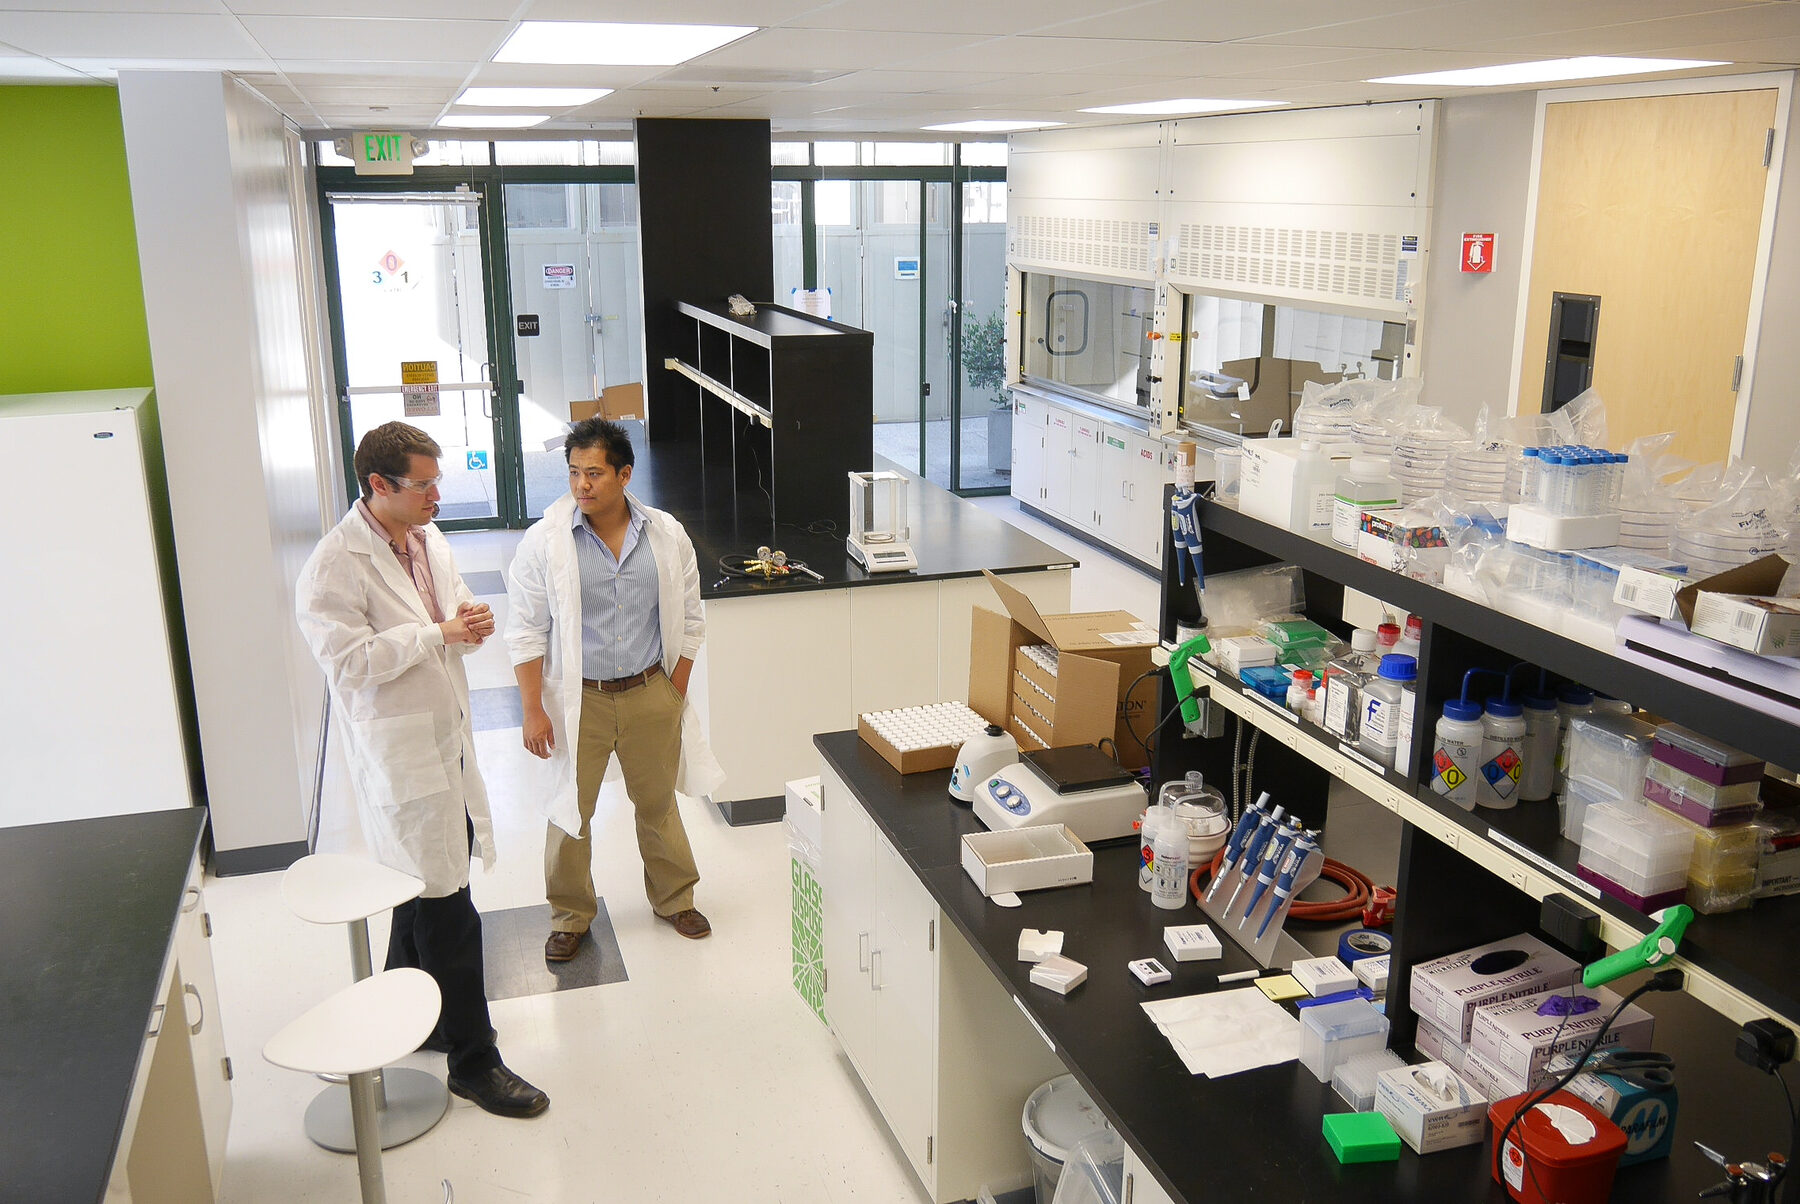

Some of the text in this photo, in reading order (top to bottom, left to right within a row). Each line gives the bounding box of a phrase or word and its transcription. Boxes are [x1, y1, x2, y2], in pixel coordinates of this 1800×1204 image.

[365, 135, 402, 161] EXIT
[386, 254, 397, 271] 0
[372, 270, 382, 284] 3
[401, 271, 408, 284] 1
[547, 267, 572, 275] DANGER
[518, 321, 538, 330] EXIT
[1140, 448, 1153, 461] ACIDS
[1360, 552, 1378, 566] Thermo
[1117, 701, 1143, 712] TON
[1447, 769, 1459, 785] 0
[791, 885, 823, 940] DISPOSA
